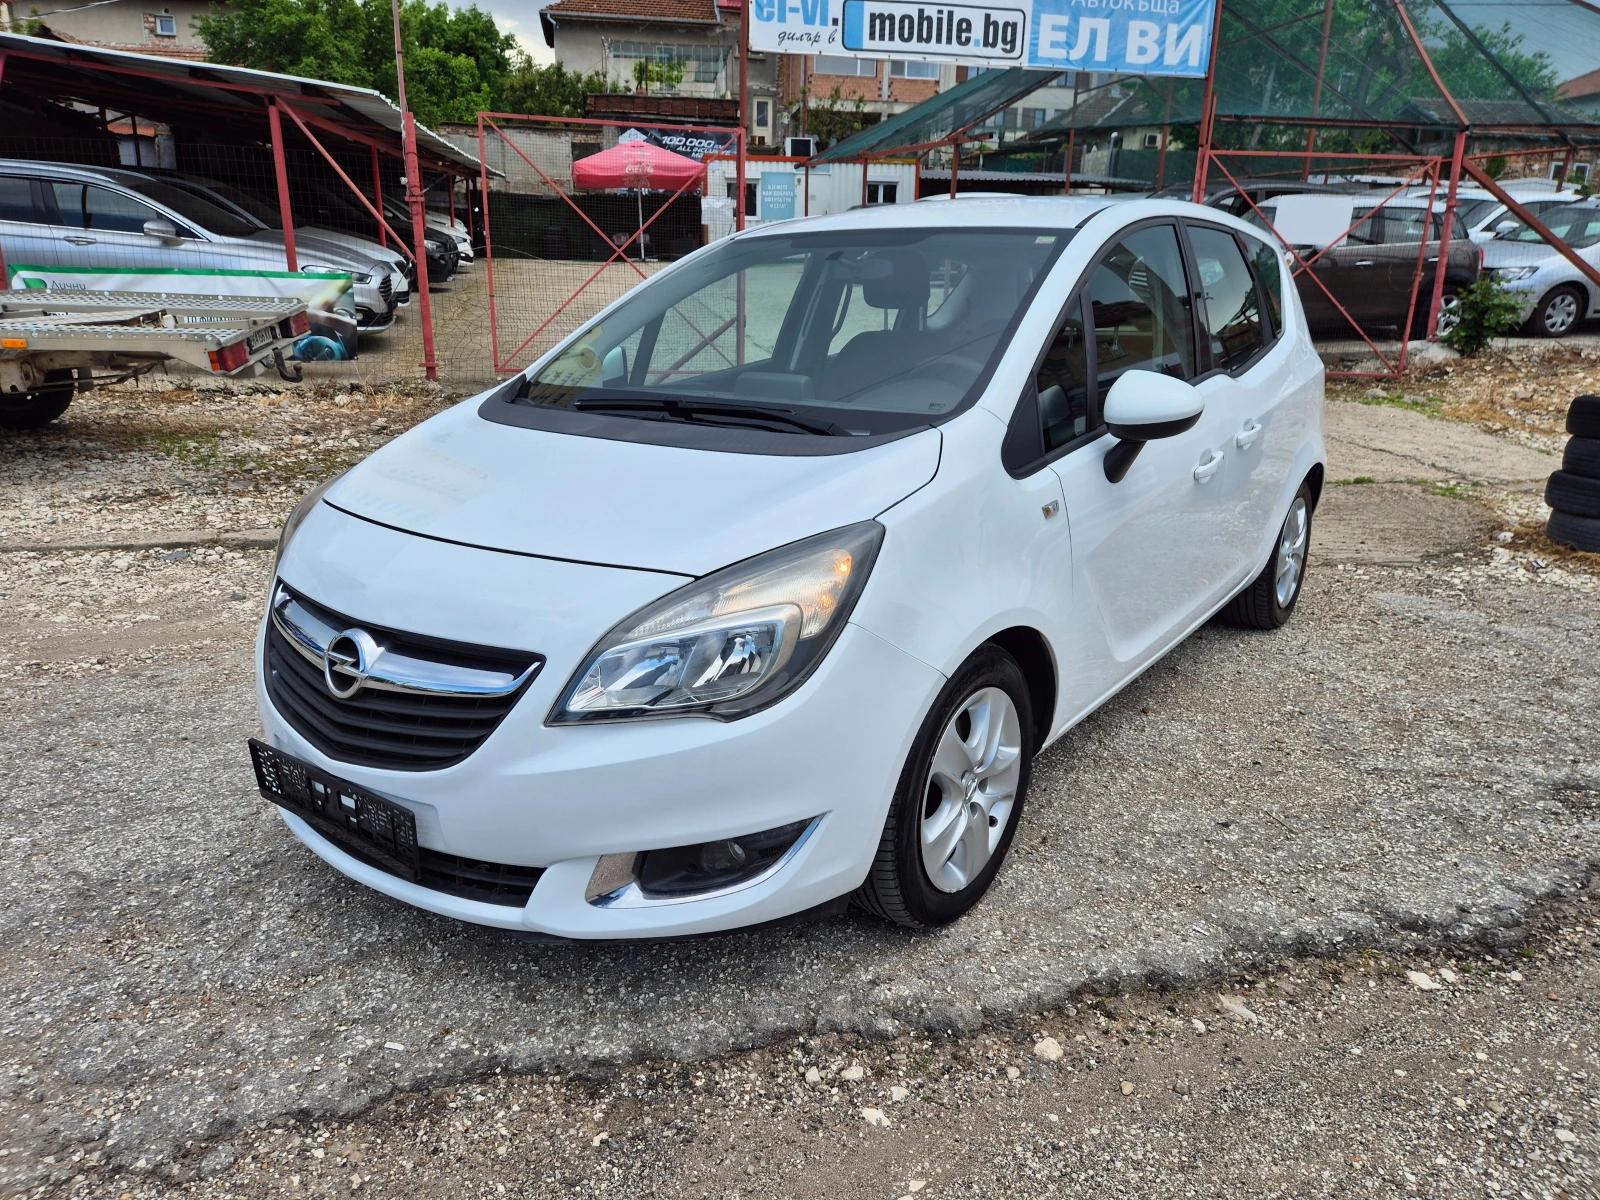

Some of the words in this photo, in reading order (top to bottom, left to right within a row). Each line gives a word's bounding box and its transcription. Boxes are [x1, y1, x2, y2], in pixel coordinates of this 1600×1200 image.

[777, 31, 821, 47] дилър
[868, 8, 1018, 54] mobile.bg
[1037, 13, 1110, 62] ЕЛ
[1125, 20, 1203, 67] ВИ
